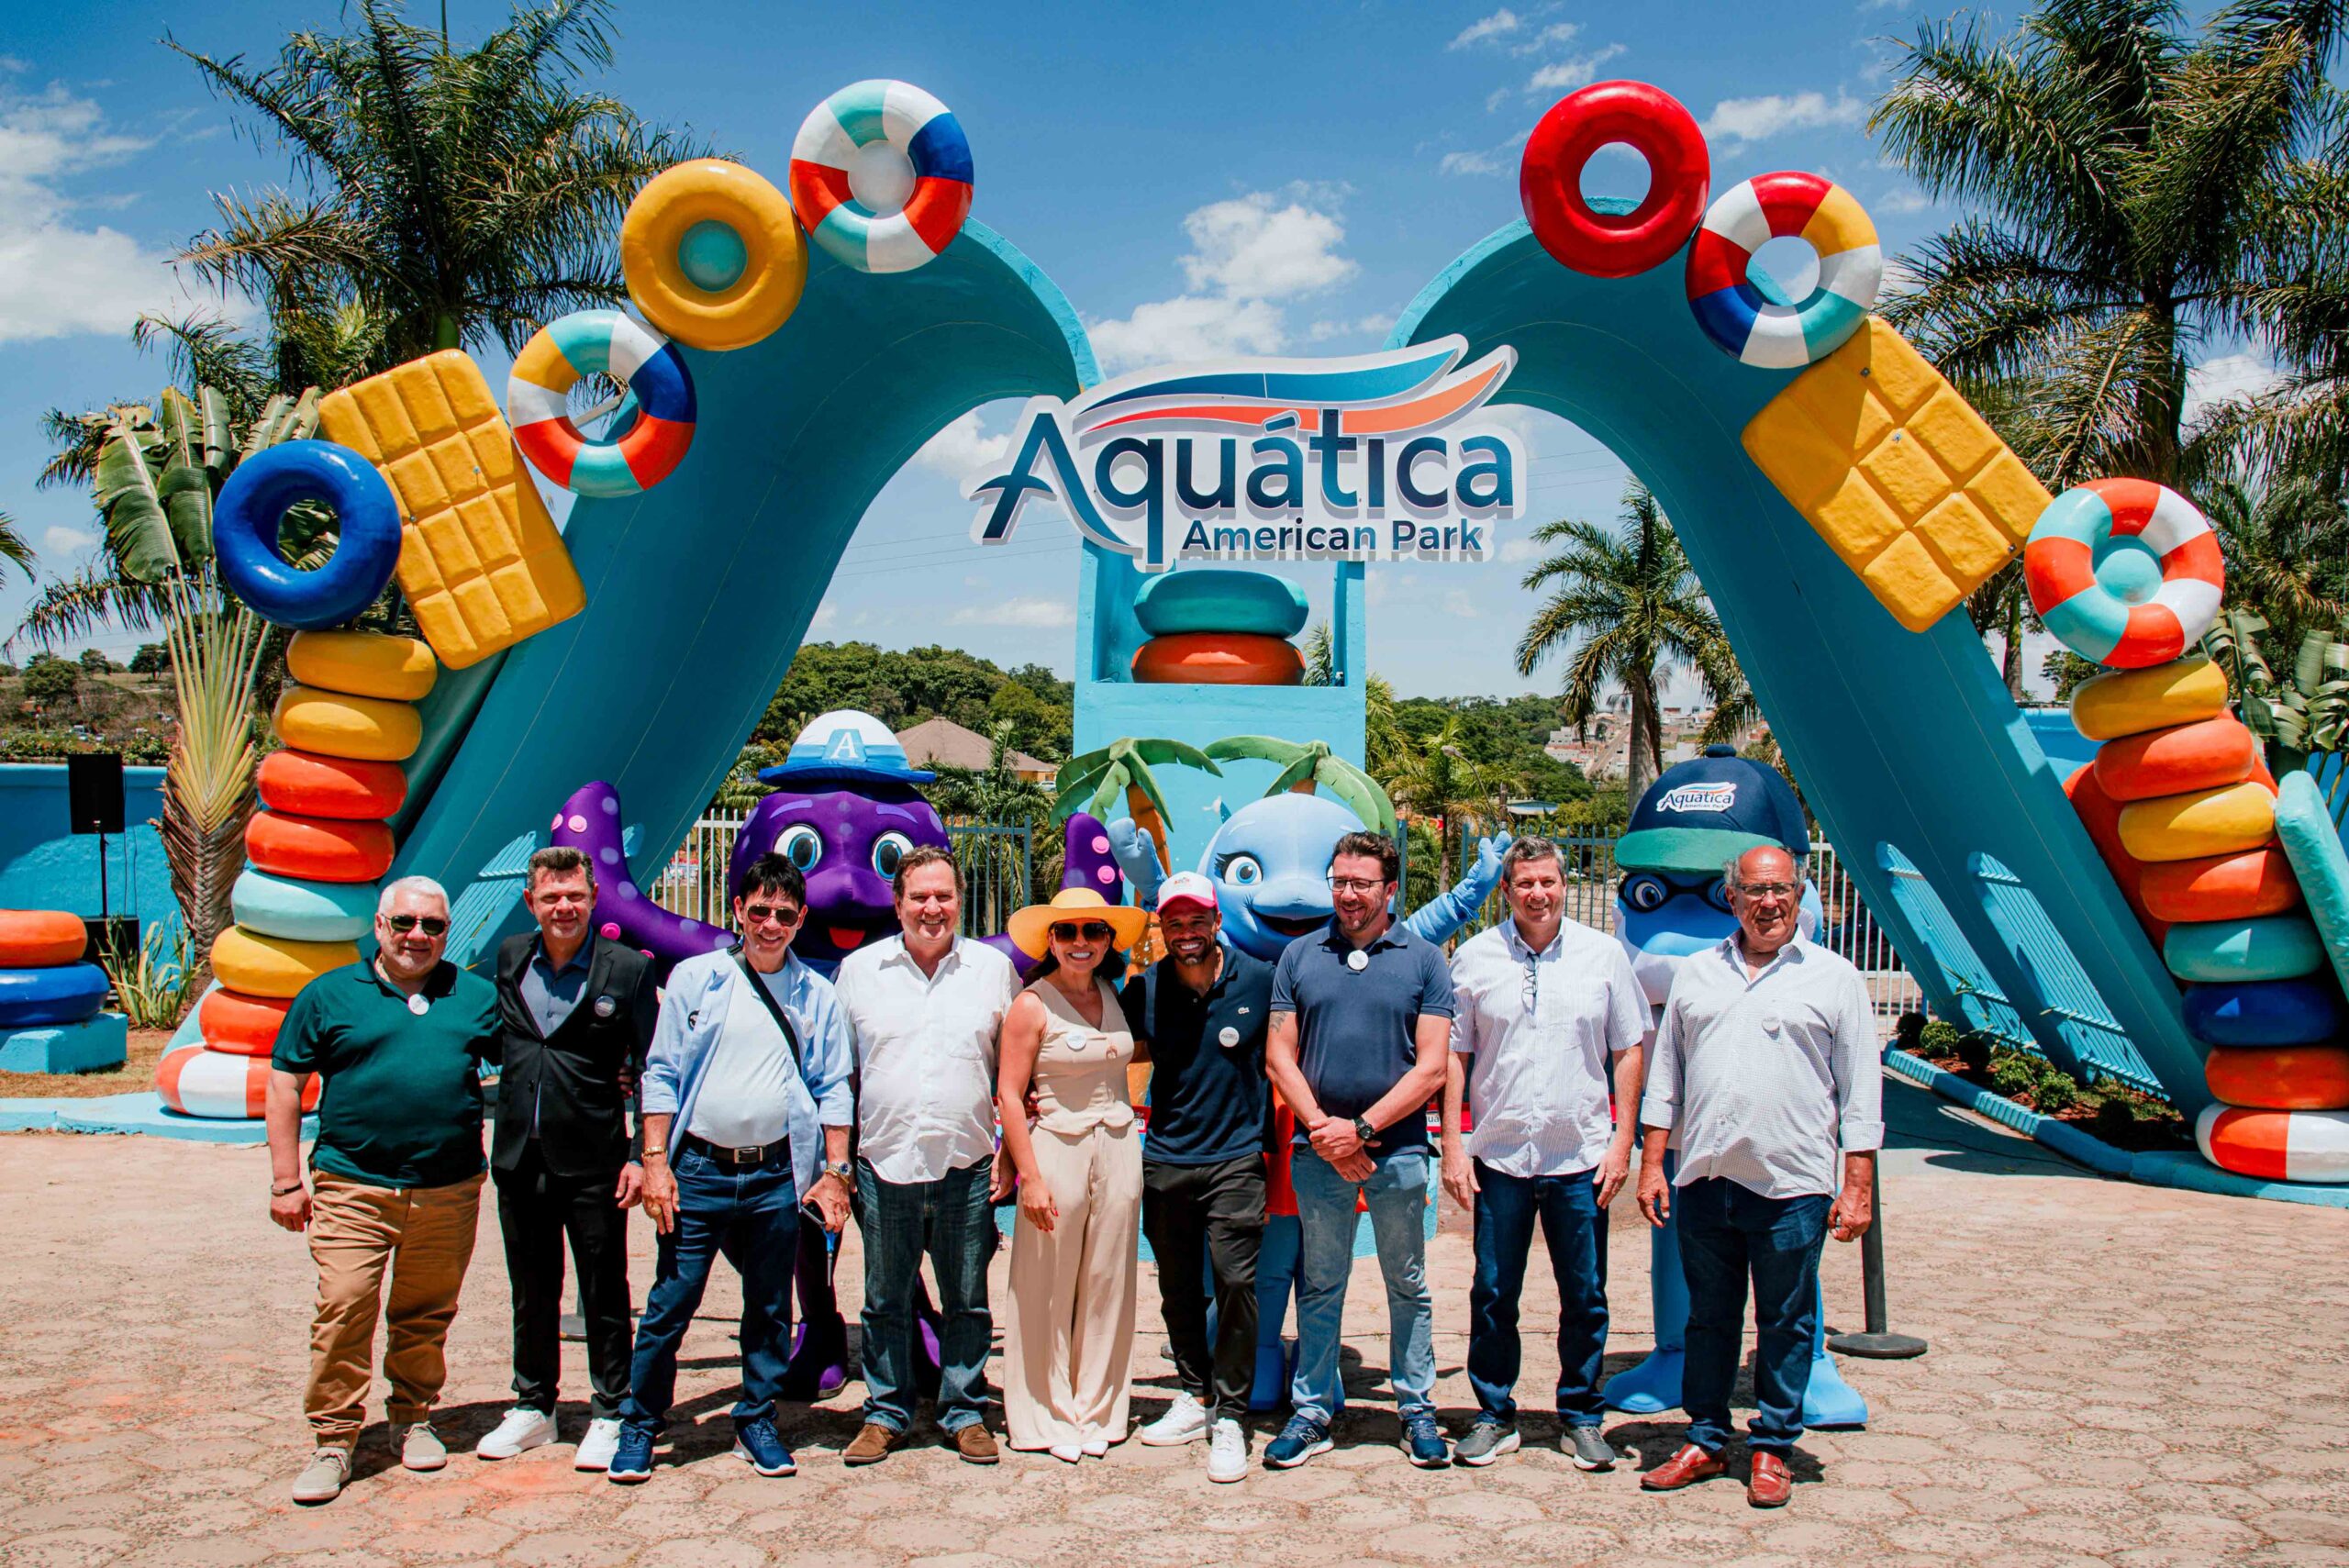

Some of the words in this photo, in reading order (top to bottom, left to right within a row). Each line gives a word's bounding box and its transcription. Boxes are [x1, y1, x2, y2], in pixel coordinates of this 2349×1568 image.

[973, 408, 1514, 564] Aquática
[1182, 517, 1376, 550] American
[1392, 518, 1482, 550] Park
[830, 731, 859, 759] A
